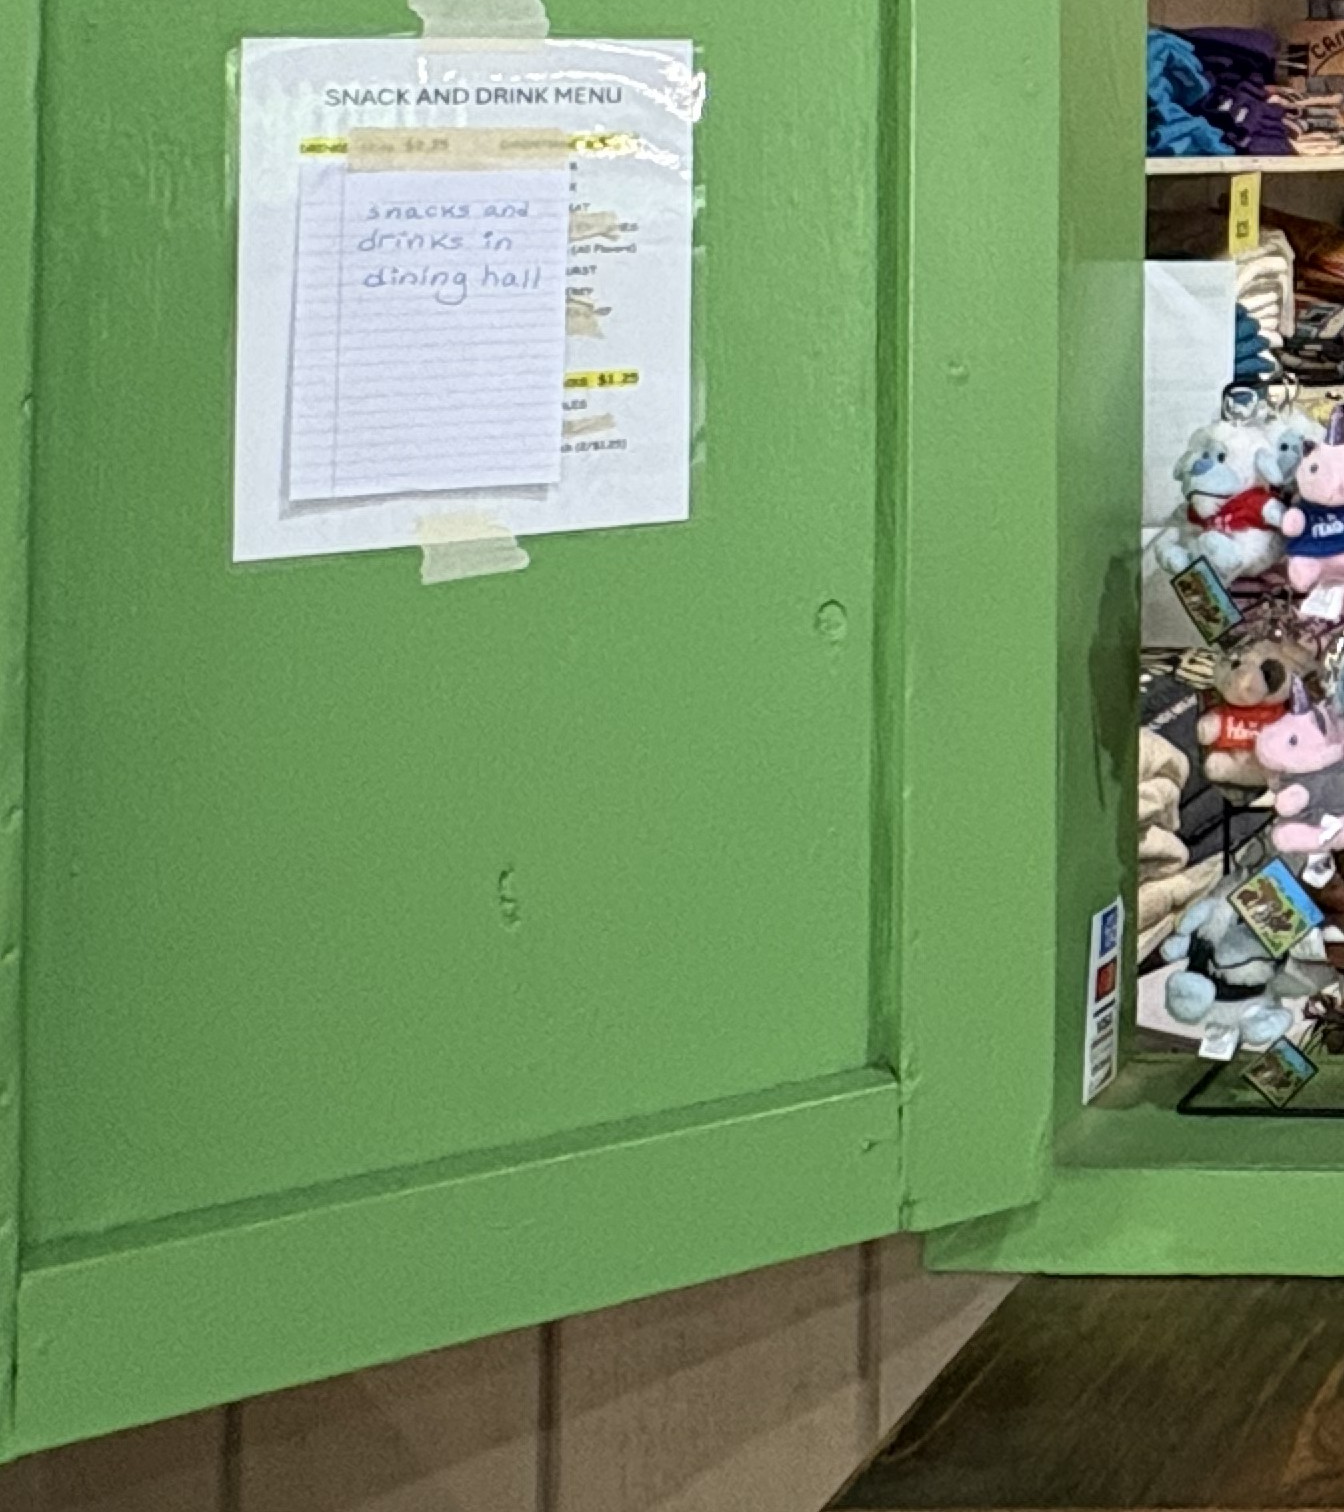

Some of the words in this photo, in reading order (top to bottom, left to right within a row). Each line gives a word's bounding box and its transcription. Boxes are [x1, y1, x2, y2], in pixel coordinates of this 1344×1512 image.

[325, 87, 411, 106] SNACK
[416, 87, 470, 106] AND
[476, 86, 549, 105] DRINK
[554, 86, 622, 104] MENU
[366, 201, 471, 220] snacks
[484, 200, 529, 218] and
[357, 228, 464, 252] drinks
[483, 230, 513, 251] in
[363, 266, 469, 306] dining
[481, 263, 542, 289] hall
